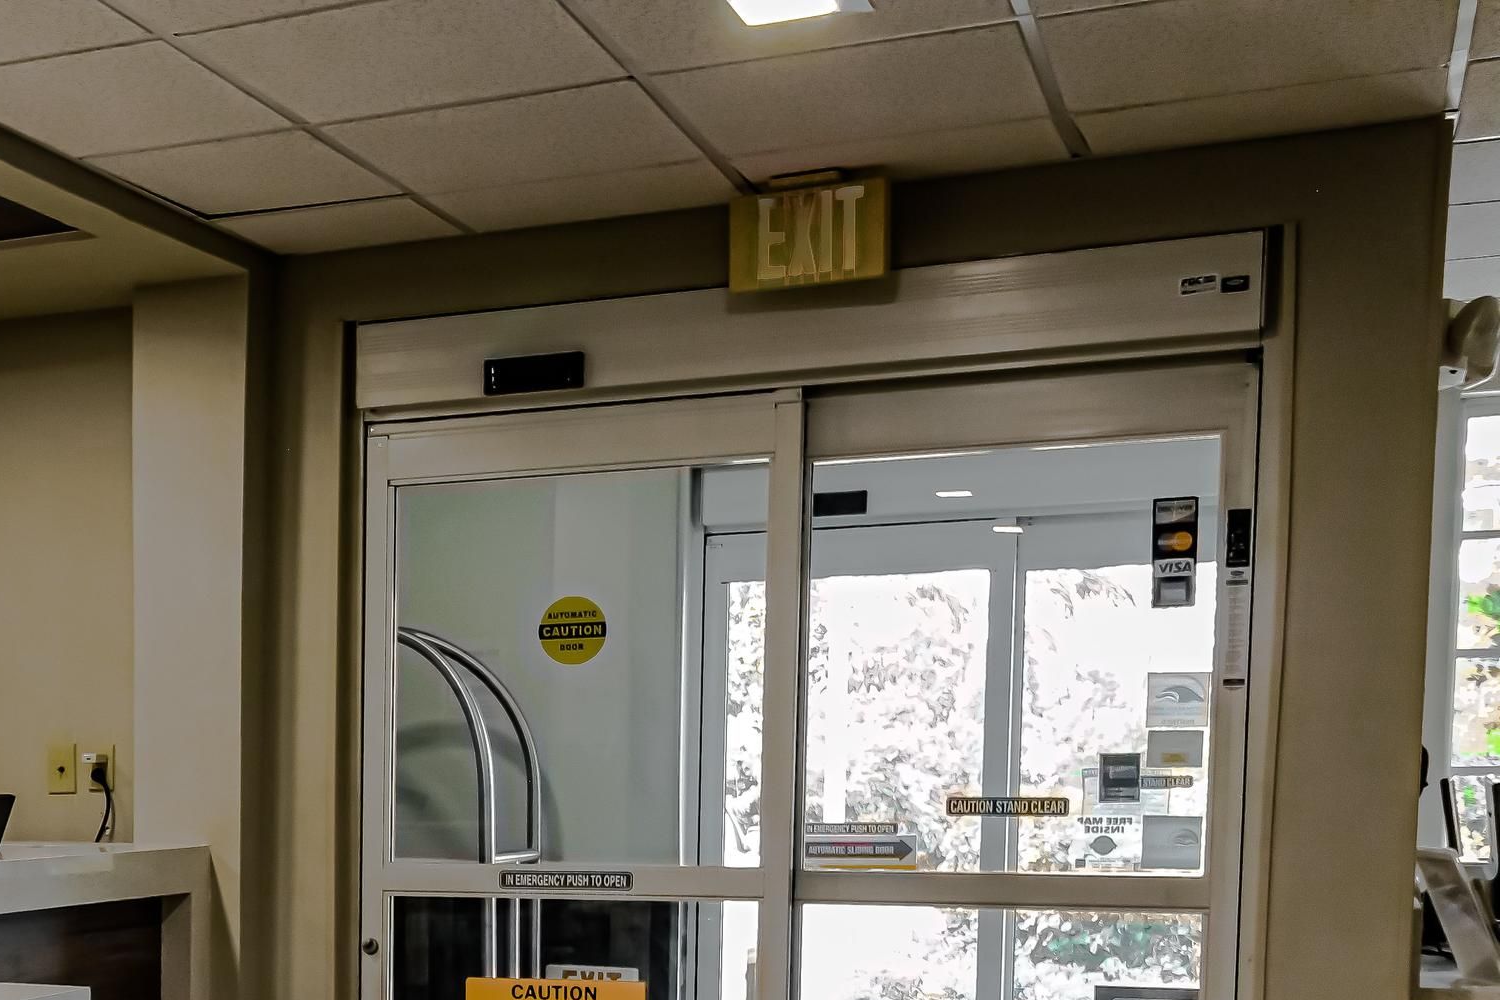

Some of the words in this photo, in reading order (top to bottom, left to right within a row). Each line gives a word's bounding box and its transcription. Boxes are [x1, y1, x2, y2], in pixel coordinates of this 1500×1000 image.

[757, 186, 864, 280] EXIT
[1159, 561, 1192, 574] VISA
[548, 610, 597, 619] AUTOMATIC
[543, 625, 602, 637] CAUTION
[560, 643, 584, 651] DOOR
[950, 799, 993, 814] CAUTION
[996, 799, 1029, 814] STAND
[1031, 799, 1065, 814] CLEAR
[850, 824, 867, 833] PUSH
[868, 824, 877, 833] TO
[877, 825, 894, 833] OPEN
[505, 874, 513, 885] IN
[515, 874, 565, 886] EMERGENCY
[567, 874, 588, 886] PUSH
[590, 875, 602, 886] TO
[603, 875, 627, 887] OPEN
